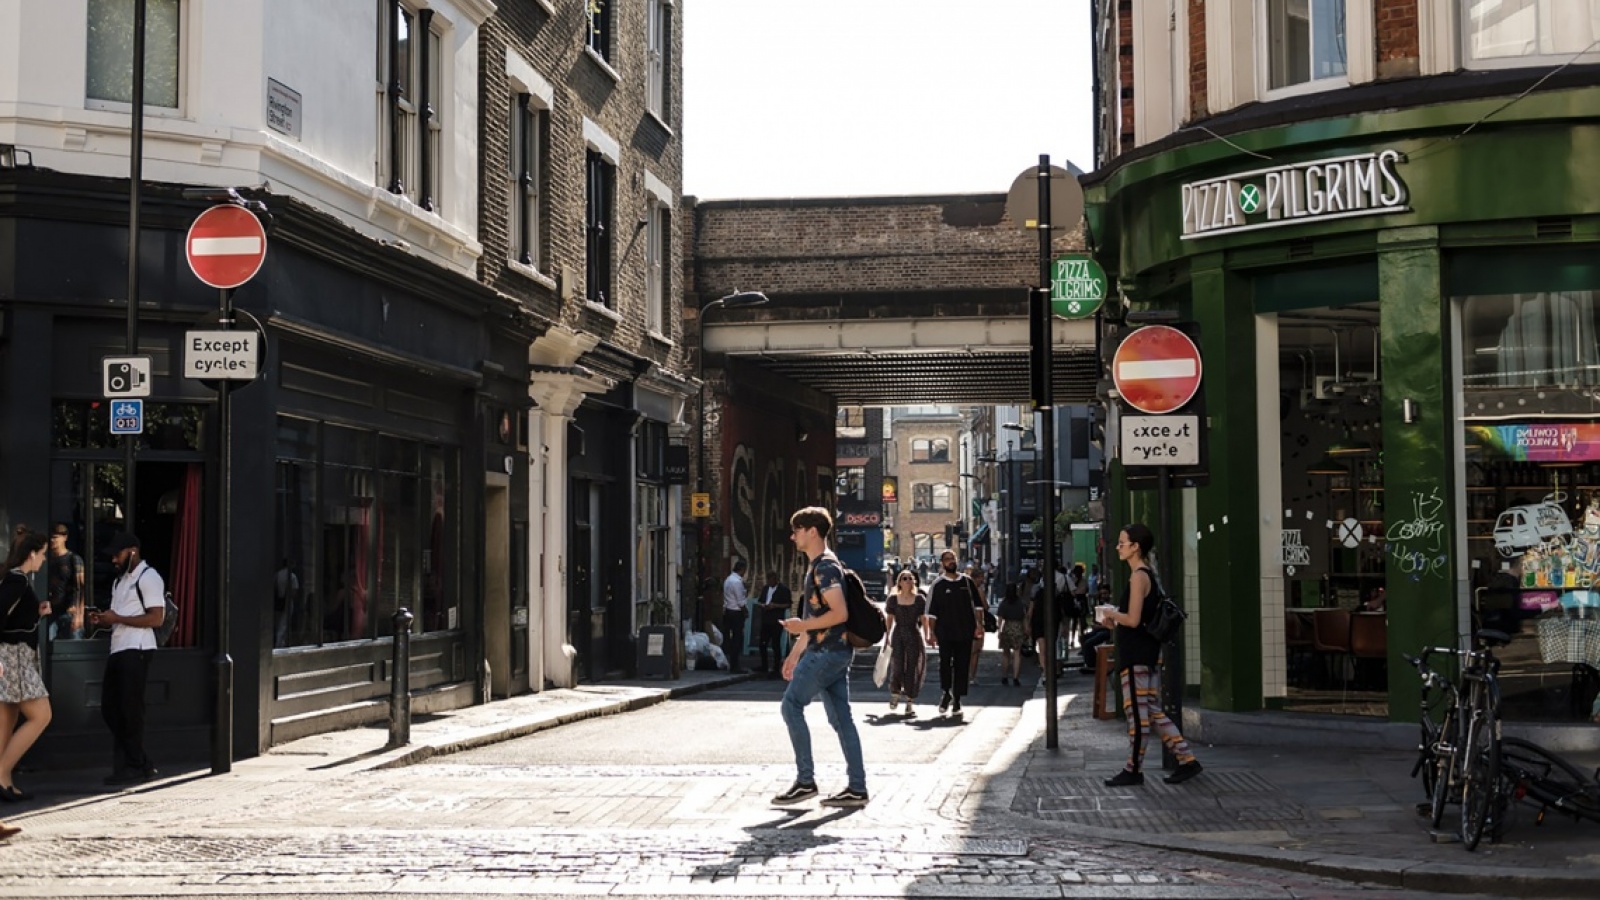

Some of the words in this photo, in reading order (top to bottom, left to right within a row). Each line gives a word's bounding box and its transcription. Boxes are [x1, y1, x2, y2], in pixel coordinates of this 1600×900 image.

[1182, 180, 1238, 235] PIZZA
[1266, 150, 1402, 220] PILGRIMS
[1057, 261, 1089, 280] PIZZA
[193, 338, 249, 354] Except
